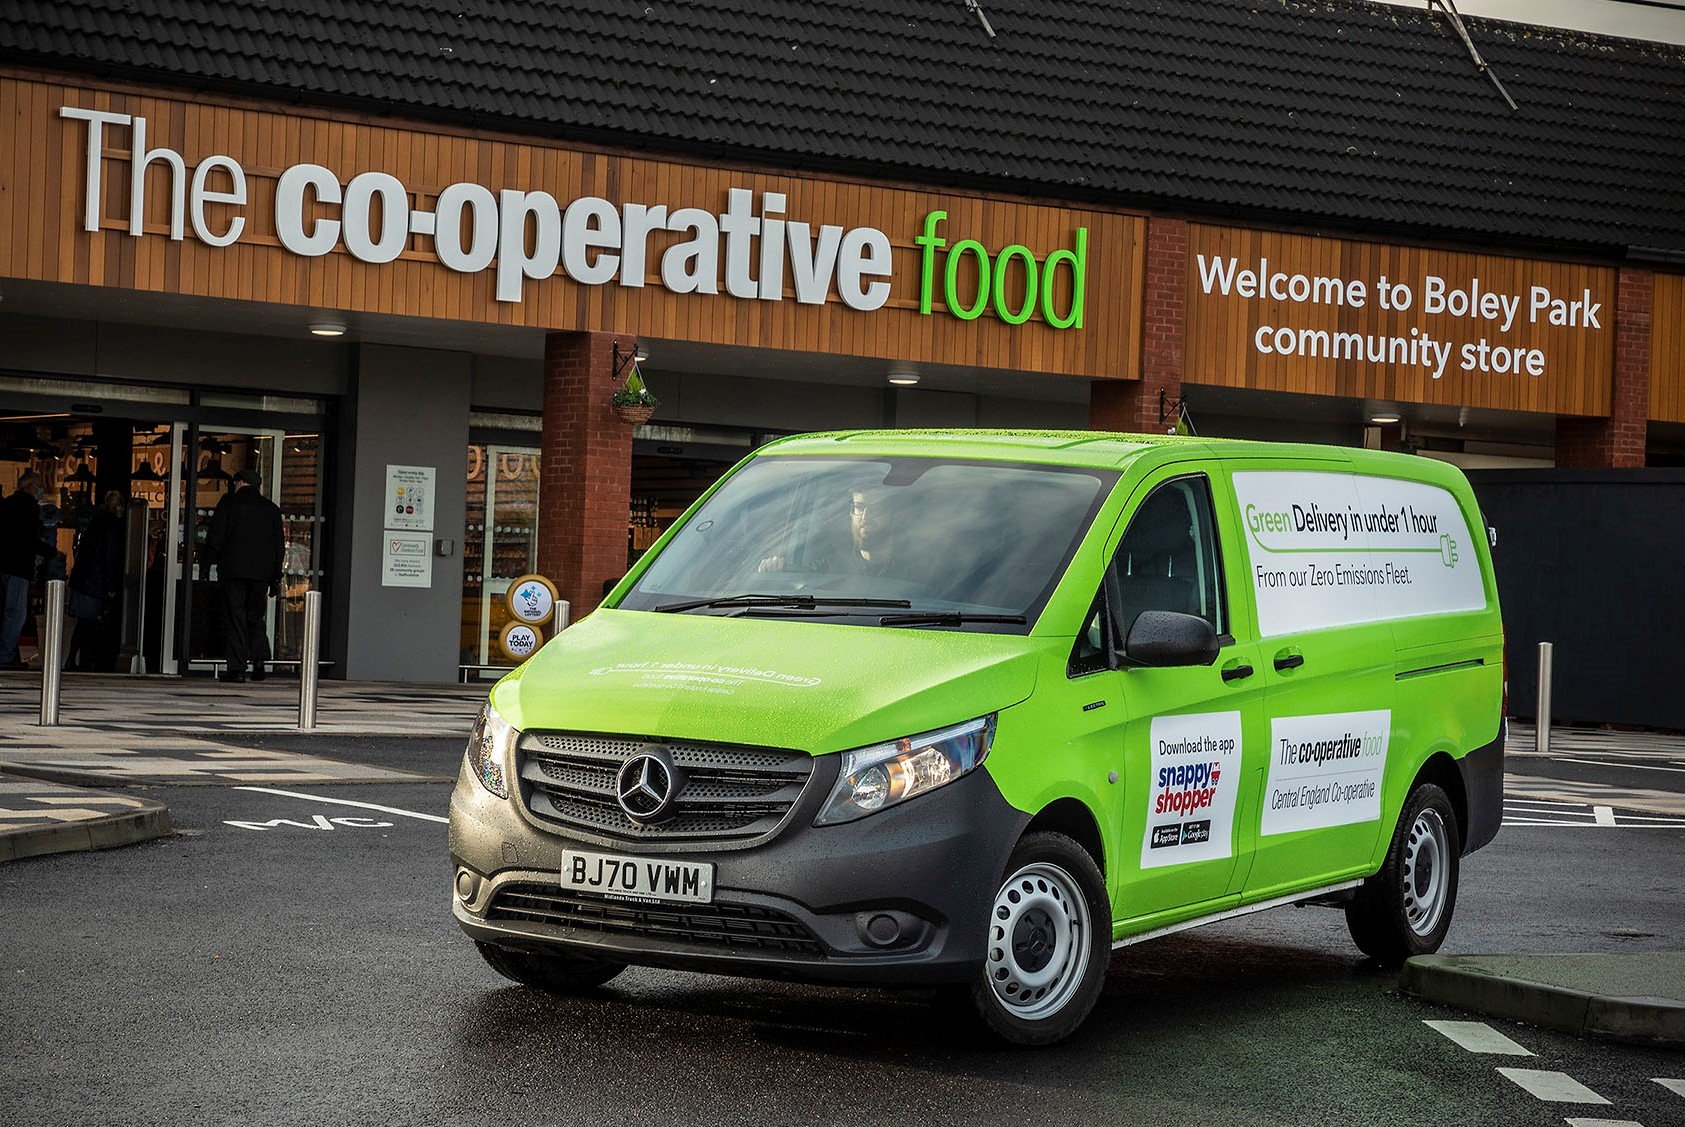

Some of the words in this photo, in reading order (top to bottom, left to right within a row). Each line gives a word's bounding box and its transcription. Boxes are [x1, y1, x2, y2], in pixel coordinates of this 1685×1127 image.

[59, 106, 247, 247] The
[275, 163, 892, 311] co-operative
[915, 210, 1087, 329] food
[1197, 254, 1366, 308] Welcome
[1377, 276, 1412, 311] to
[1425, 276, 1520, 332] Boley
[1530, 286, 1602, 329] Park
[1255, 325, 1452, 379] community
[1460, 339, 1545, 376] store
[1245, 503, 1292, 533] Green
[1292, 503, 1348, 540] Delivery
[1348, 505, 1362, 532] in
[1364, 504, 1400, 533] under
[1401, 506, 1410, 534] 1
[1410, 505, 1438, 534] hour
[1256, 565, 1287, 588] From
[1289, 569, 1308, 587] our
[1309, 564, 1334, 586] Zero
[1336, 563, 1385, 586] Emissions
[1386, 562, 1412, 585] Fleet.
[509, 640, 534, 648] TODAY
[1159, 735, 1203, 756] Download
[1204, 735, 1217, 752] the
[1219, 738, 1235, 756] app
[1280, 738, 1296, 765] The
[1298, 733, 1361, 767] co-operative
[1362, 731, 1383, 757] food
[1158, 761, 1212, 788] snappy
[1155, 786, 1217, 817] shopper
[1272, 787, 1300, 810] Central
[1301, 783, 1331, 810] England
[1331, 781, 1375, 806] Co-operative
[571, 856, 637, 890] BJ70
[647, 863, 700, 897] VWM
